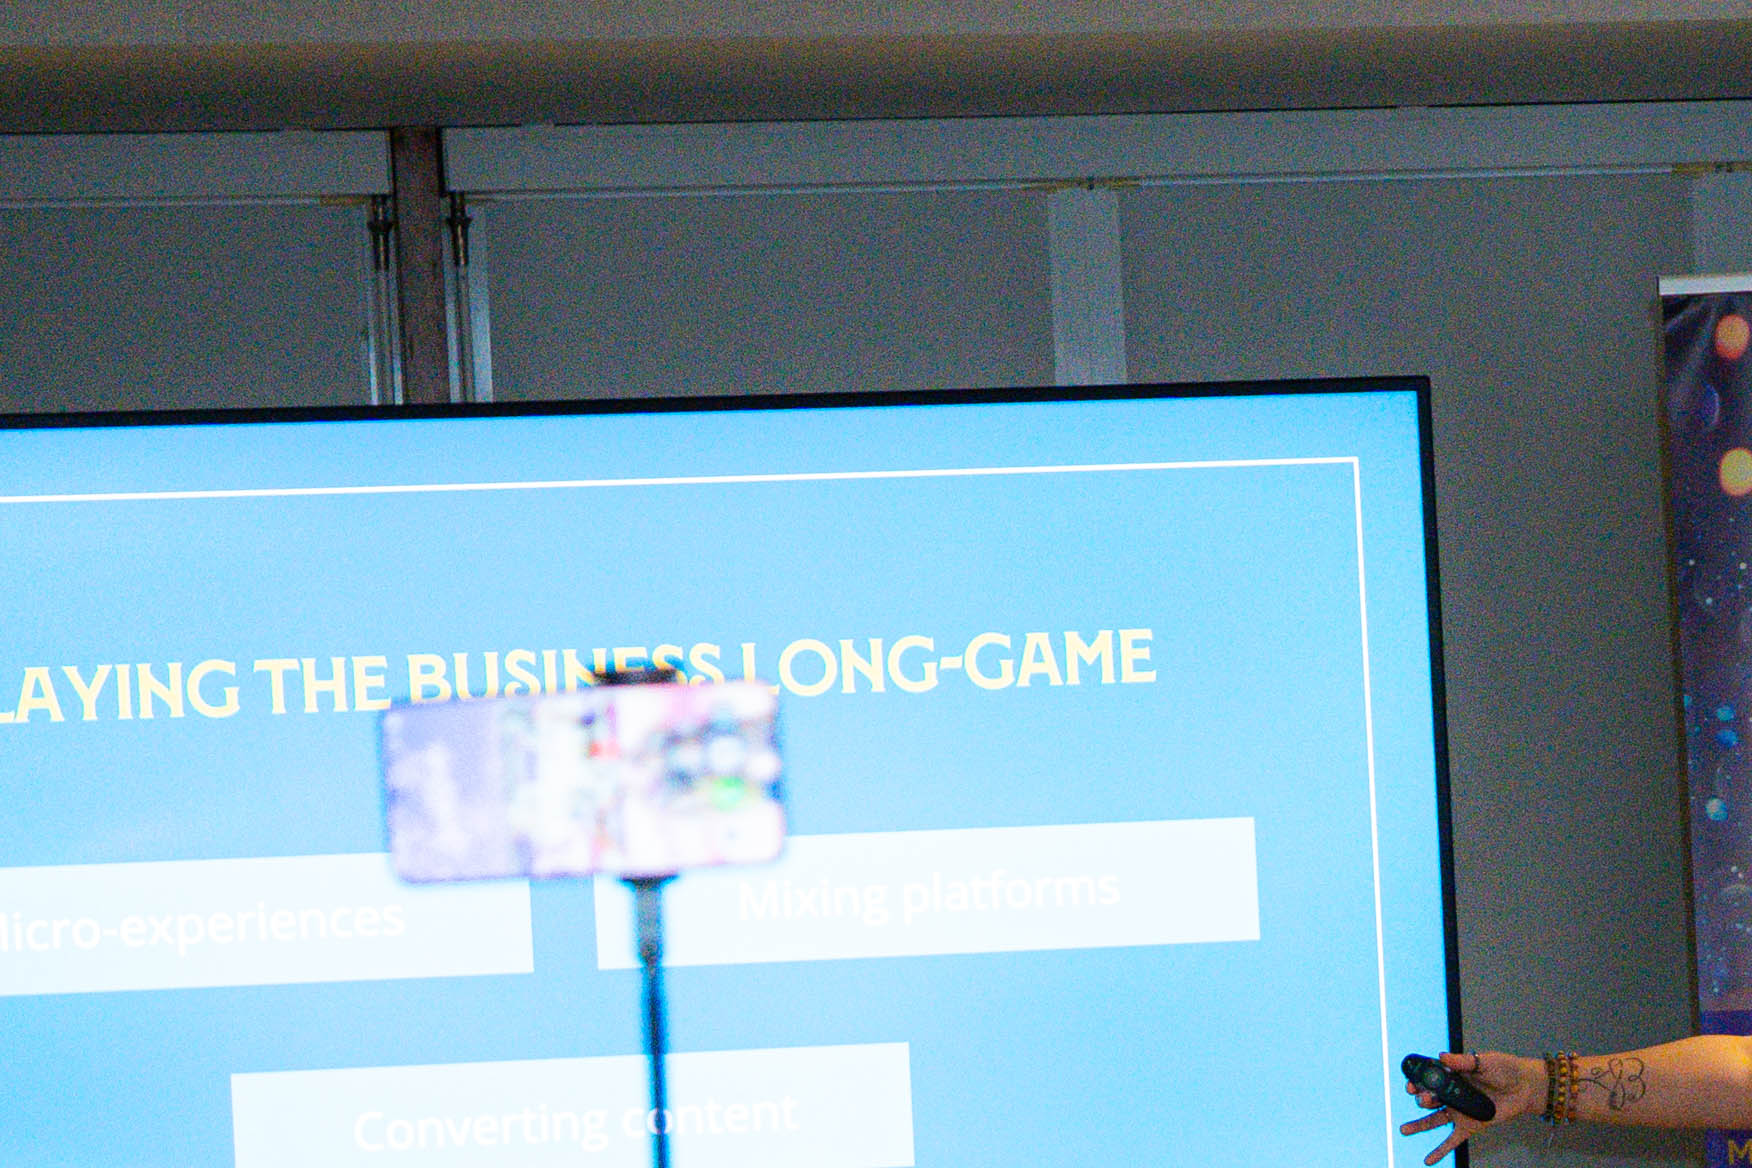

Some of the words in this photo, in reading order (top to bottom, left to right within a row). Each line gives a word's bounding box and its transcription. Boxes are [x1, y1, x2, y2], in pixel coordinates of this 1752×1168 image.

[253, 655, 391, 714] THE
[740, 629, 1157, 697] LONG-GAME
[738, 880, 890, 926] Mixing
[903, 868, 1120, 923] platforms
[354, 1103, 608, 1152] Converting
[622, 1095, 801, 1138] content
